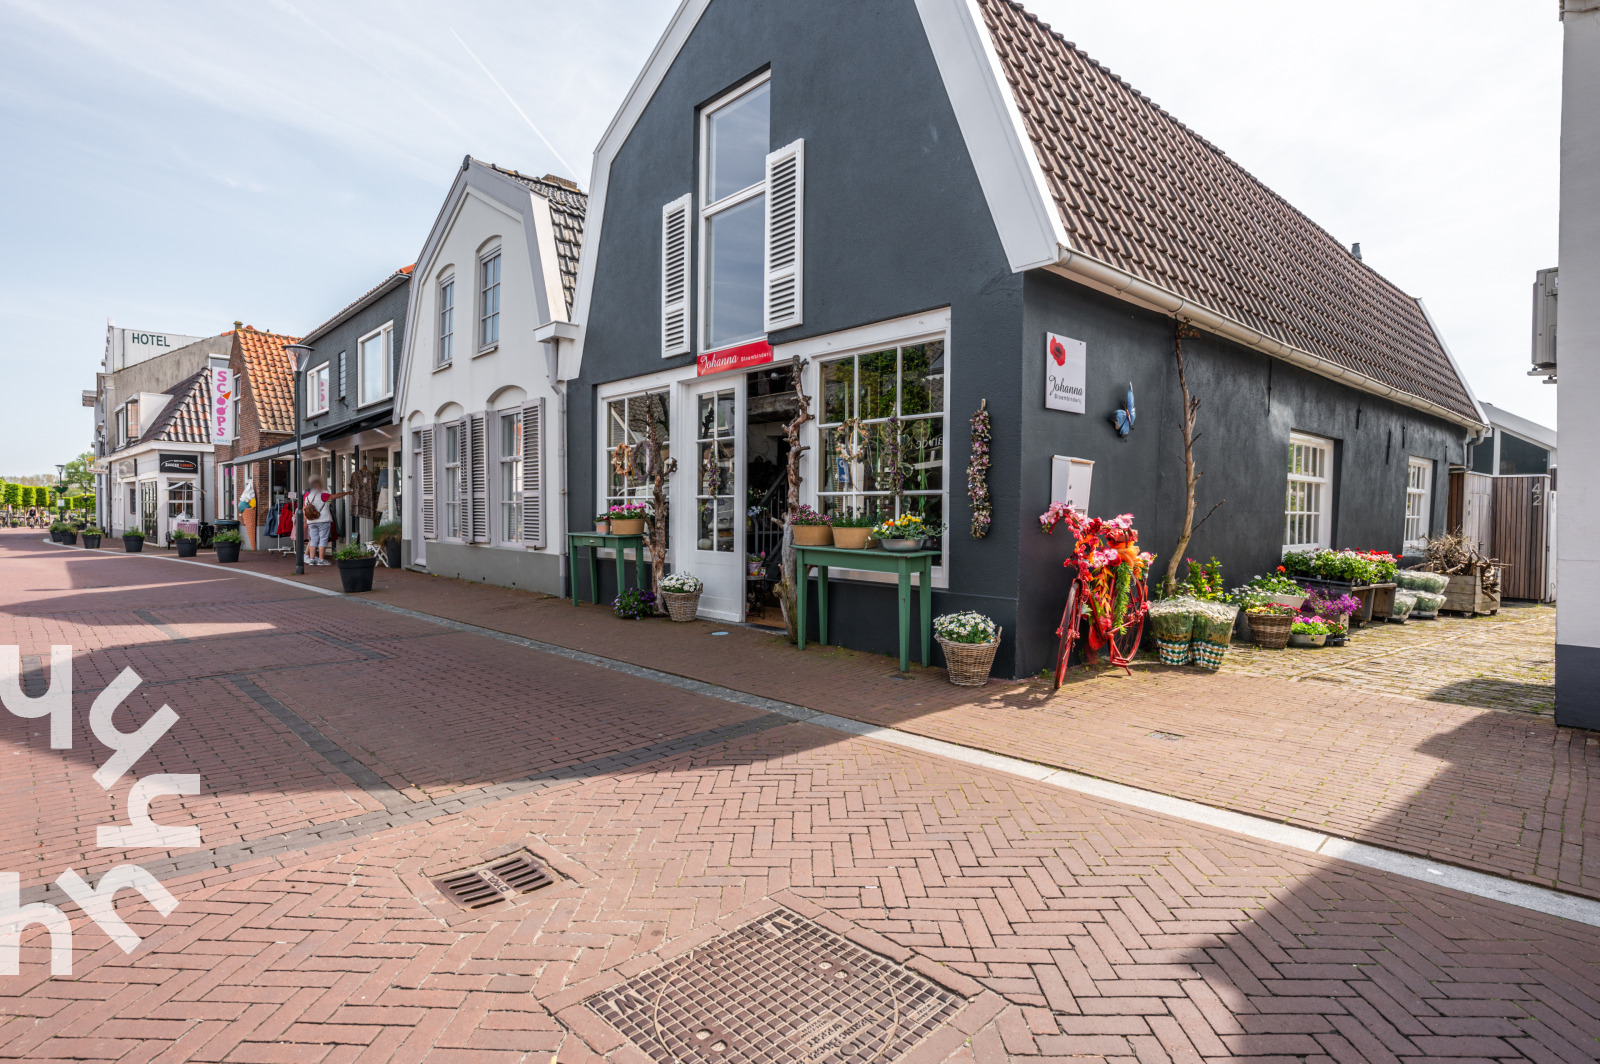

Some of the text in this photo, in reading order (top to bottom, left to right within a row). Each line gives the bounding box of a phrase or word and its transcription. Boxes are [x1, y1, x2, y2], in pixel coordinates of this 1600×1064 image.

[132, 332, 170, 348] HOTEL
[700, 351, 772, 376] Johanna Bloembinderij
[1049, 374, 1083, 404] Johanna Bloembinderij
[215, 371, 228, 437] SCOOPS
[1532, 483, 1542, 506] 42
[807, 1023, 843, 1048] WEERT
